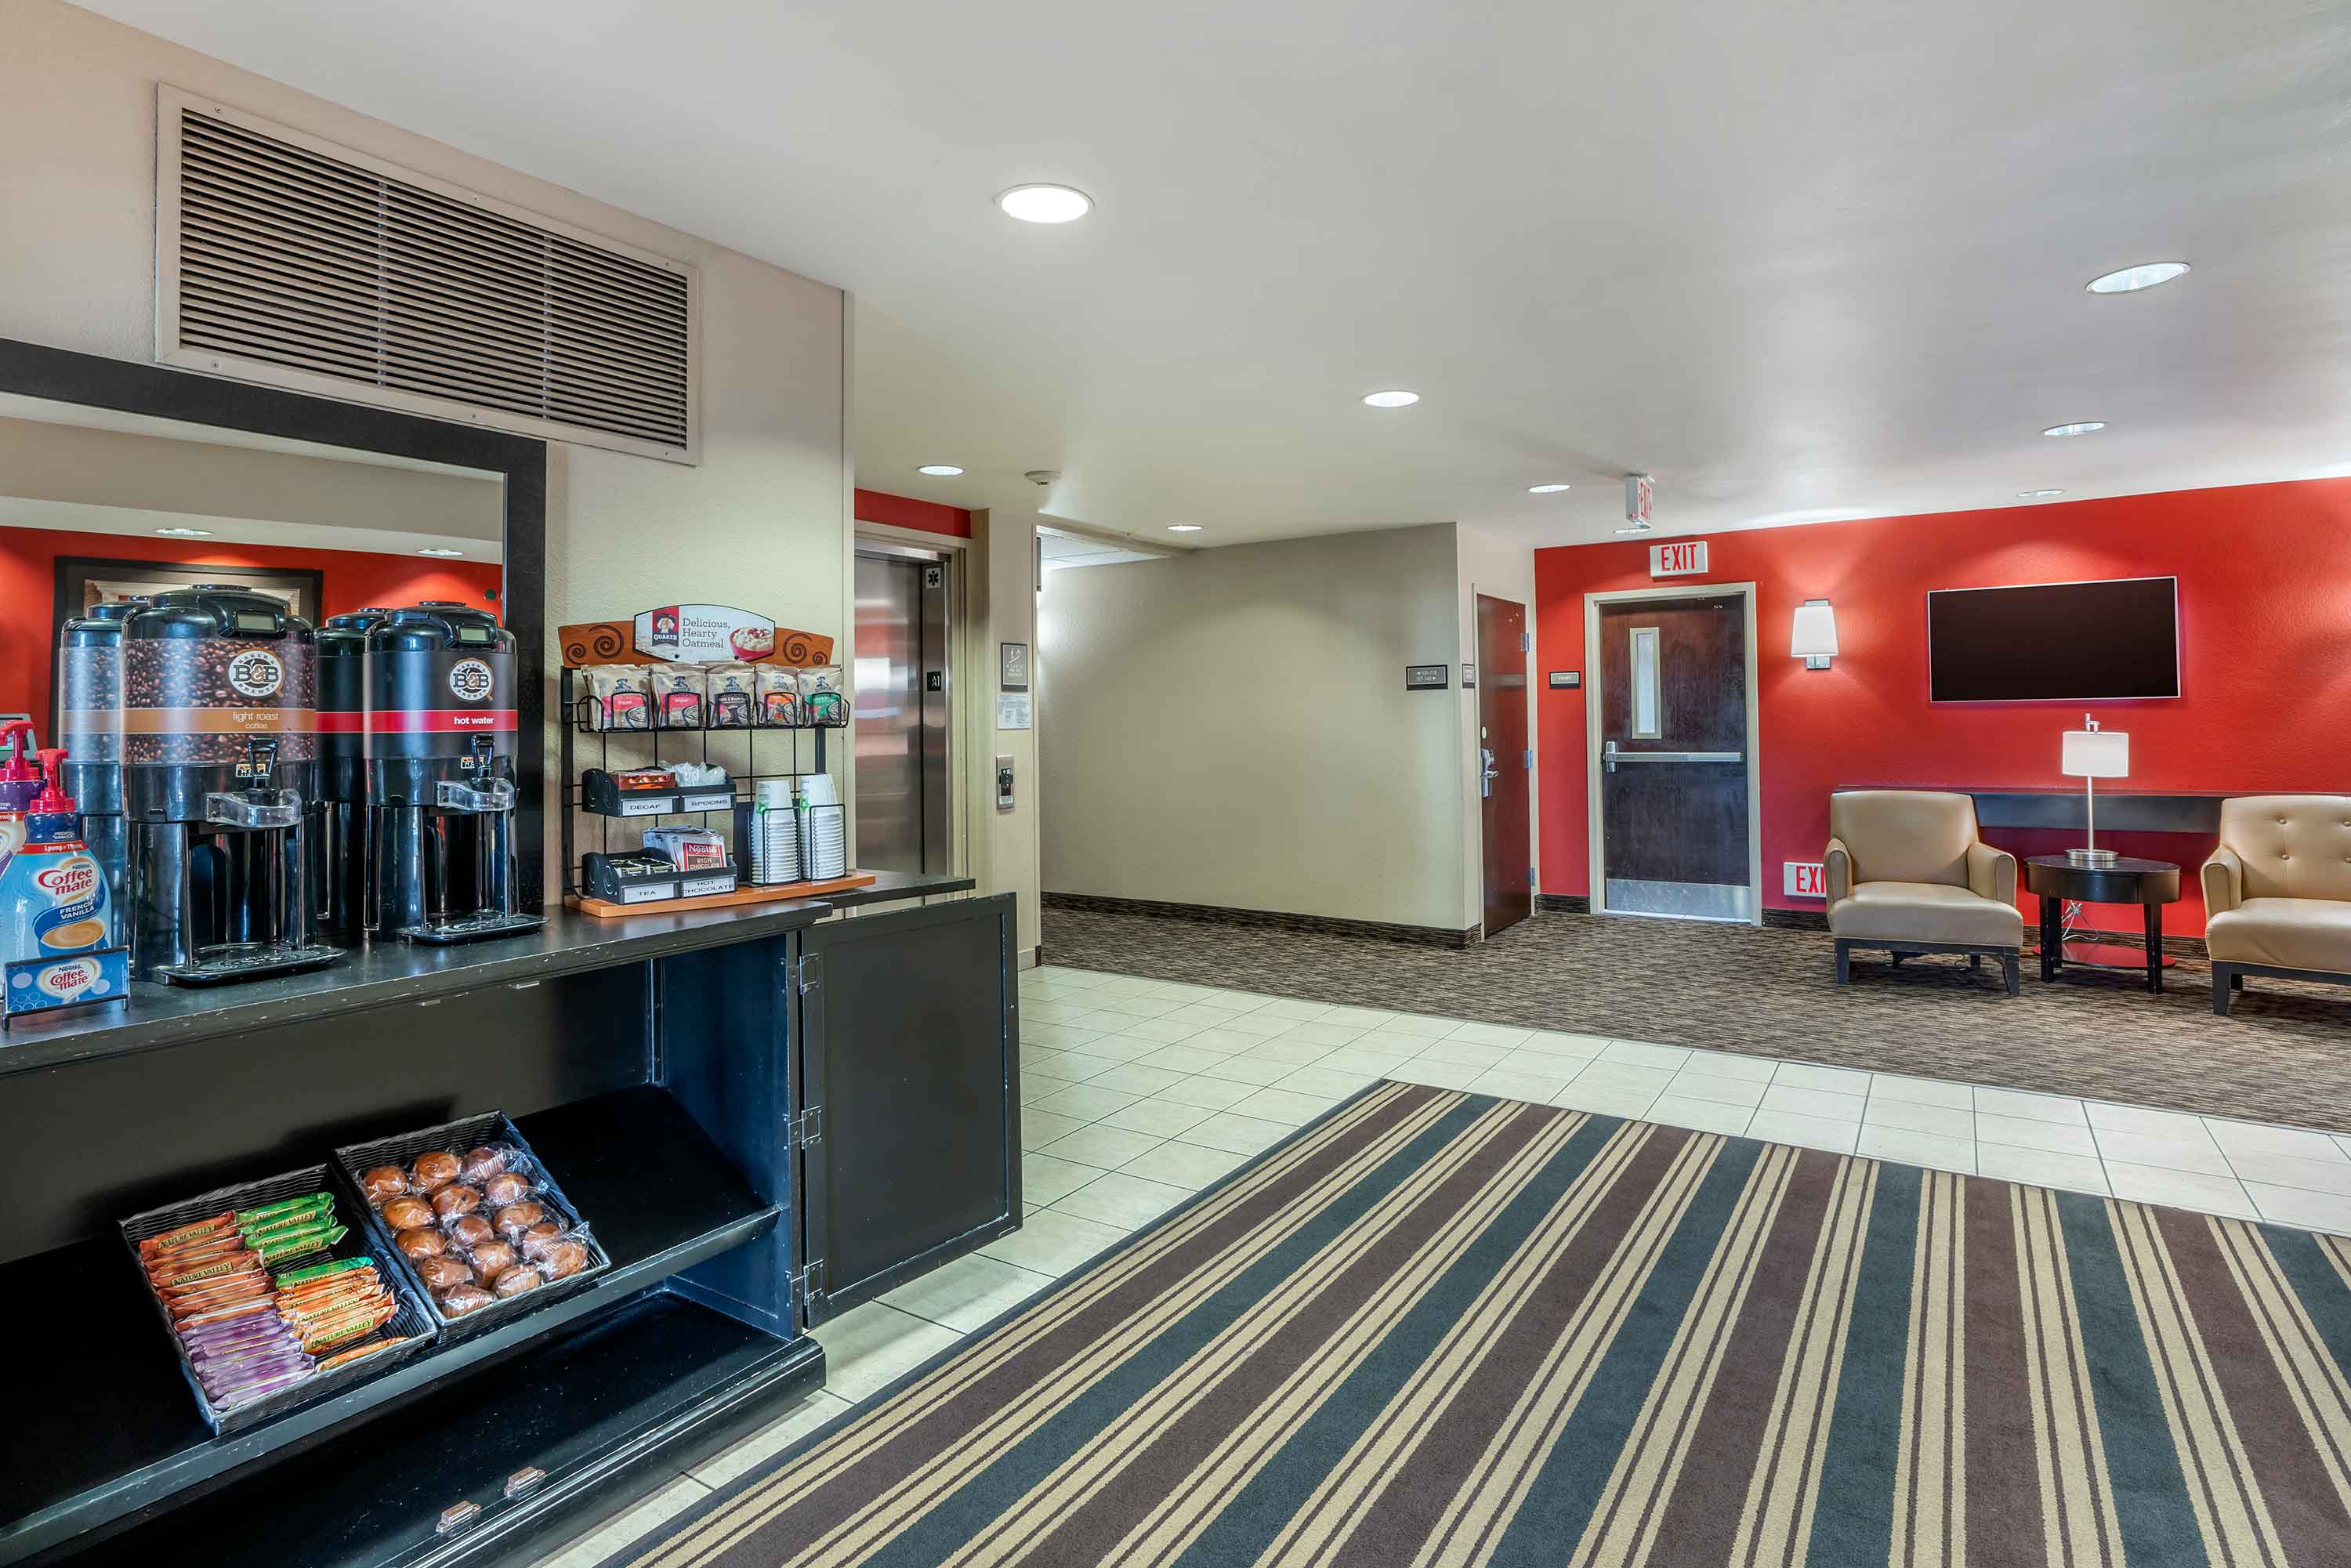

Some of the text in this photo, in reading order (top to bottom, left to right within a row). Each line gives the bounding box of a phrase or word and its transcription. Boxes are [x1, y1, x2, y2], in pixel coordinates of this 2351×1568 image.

[1661, 544, 1697, 572] EXIT
[683, 617, 730, 629] Delicious,
[683, 628, 718, 639] Hearty
[682, 639, 724, 648] Oatmeal
[233, 664, 279, 683] B&B
[452, 672, 490, 689] B&B
[232, 712, 279, 722] light roast
[454, 716, 469, 725] hot
[38, 867, 93, 889] Coffee
[1796, 865, 1825, 893] EXI
[55, 878, 92, 896] mate
[683, 884, 734, 893] CHOCOLATE
[60, 900, 94, 915] FRENCH
[61, 906, 95, 920] VANILLA
[50, 969, 85, 986] Coffee
[59, 976, 89, 991] mate
[288, 1212, 315, 1225] VALLEY
[160, 1234, 188, 1249] NATURE
[189, 1225, 215, 1239] VALLEY
[263, 1240, 321, 1263] NATURE VALLEY
[173, 1263, 230, 1285] NATURE VALLEY
[314, 1330, 343, 1345] NATURE
[346, 1320, 371, 1333] VALLEY
